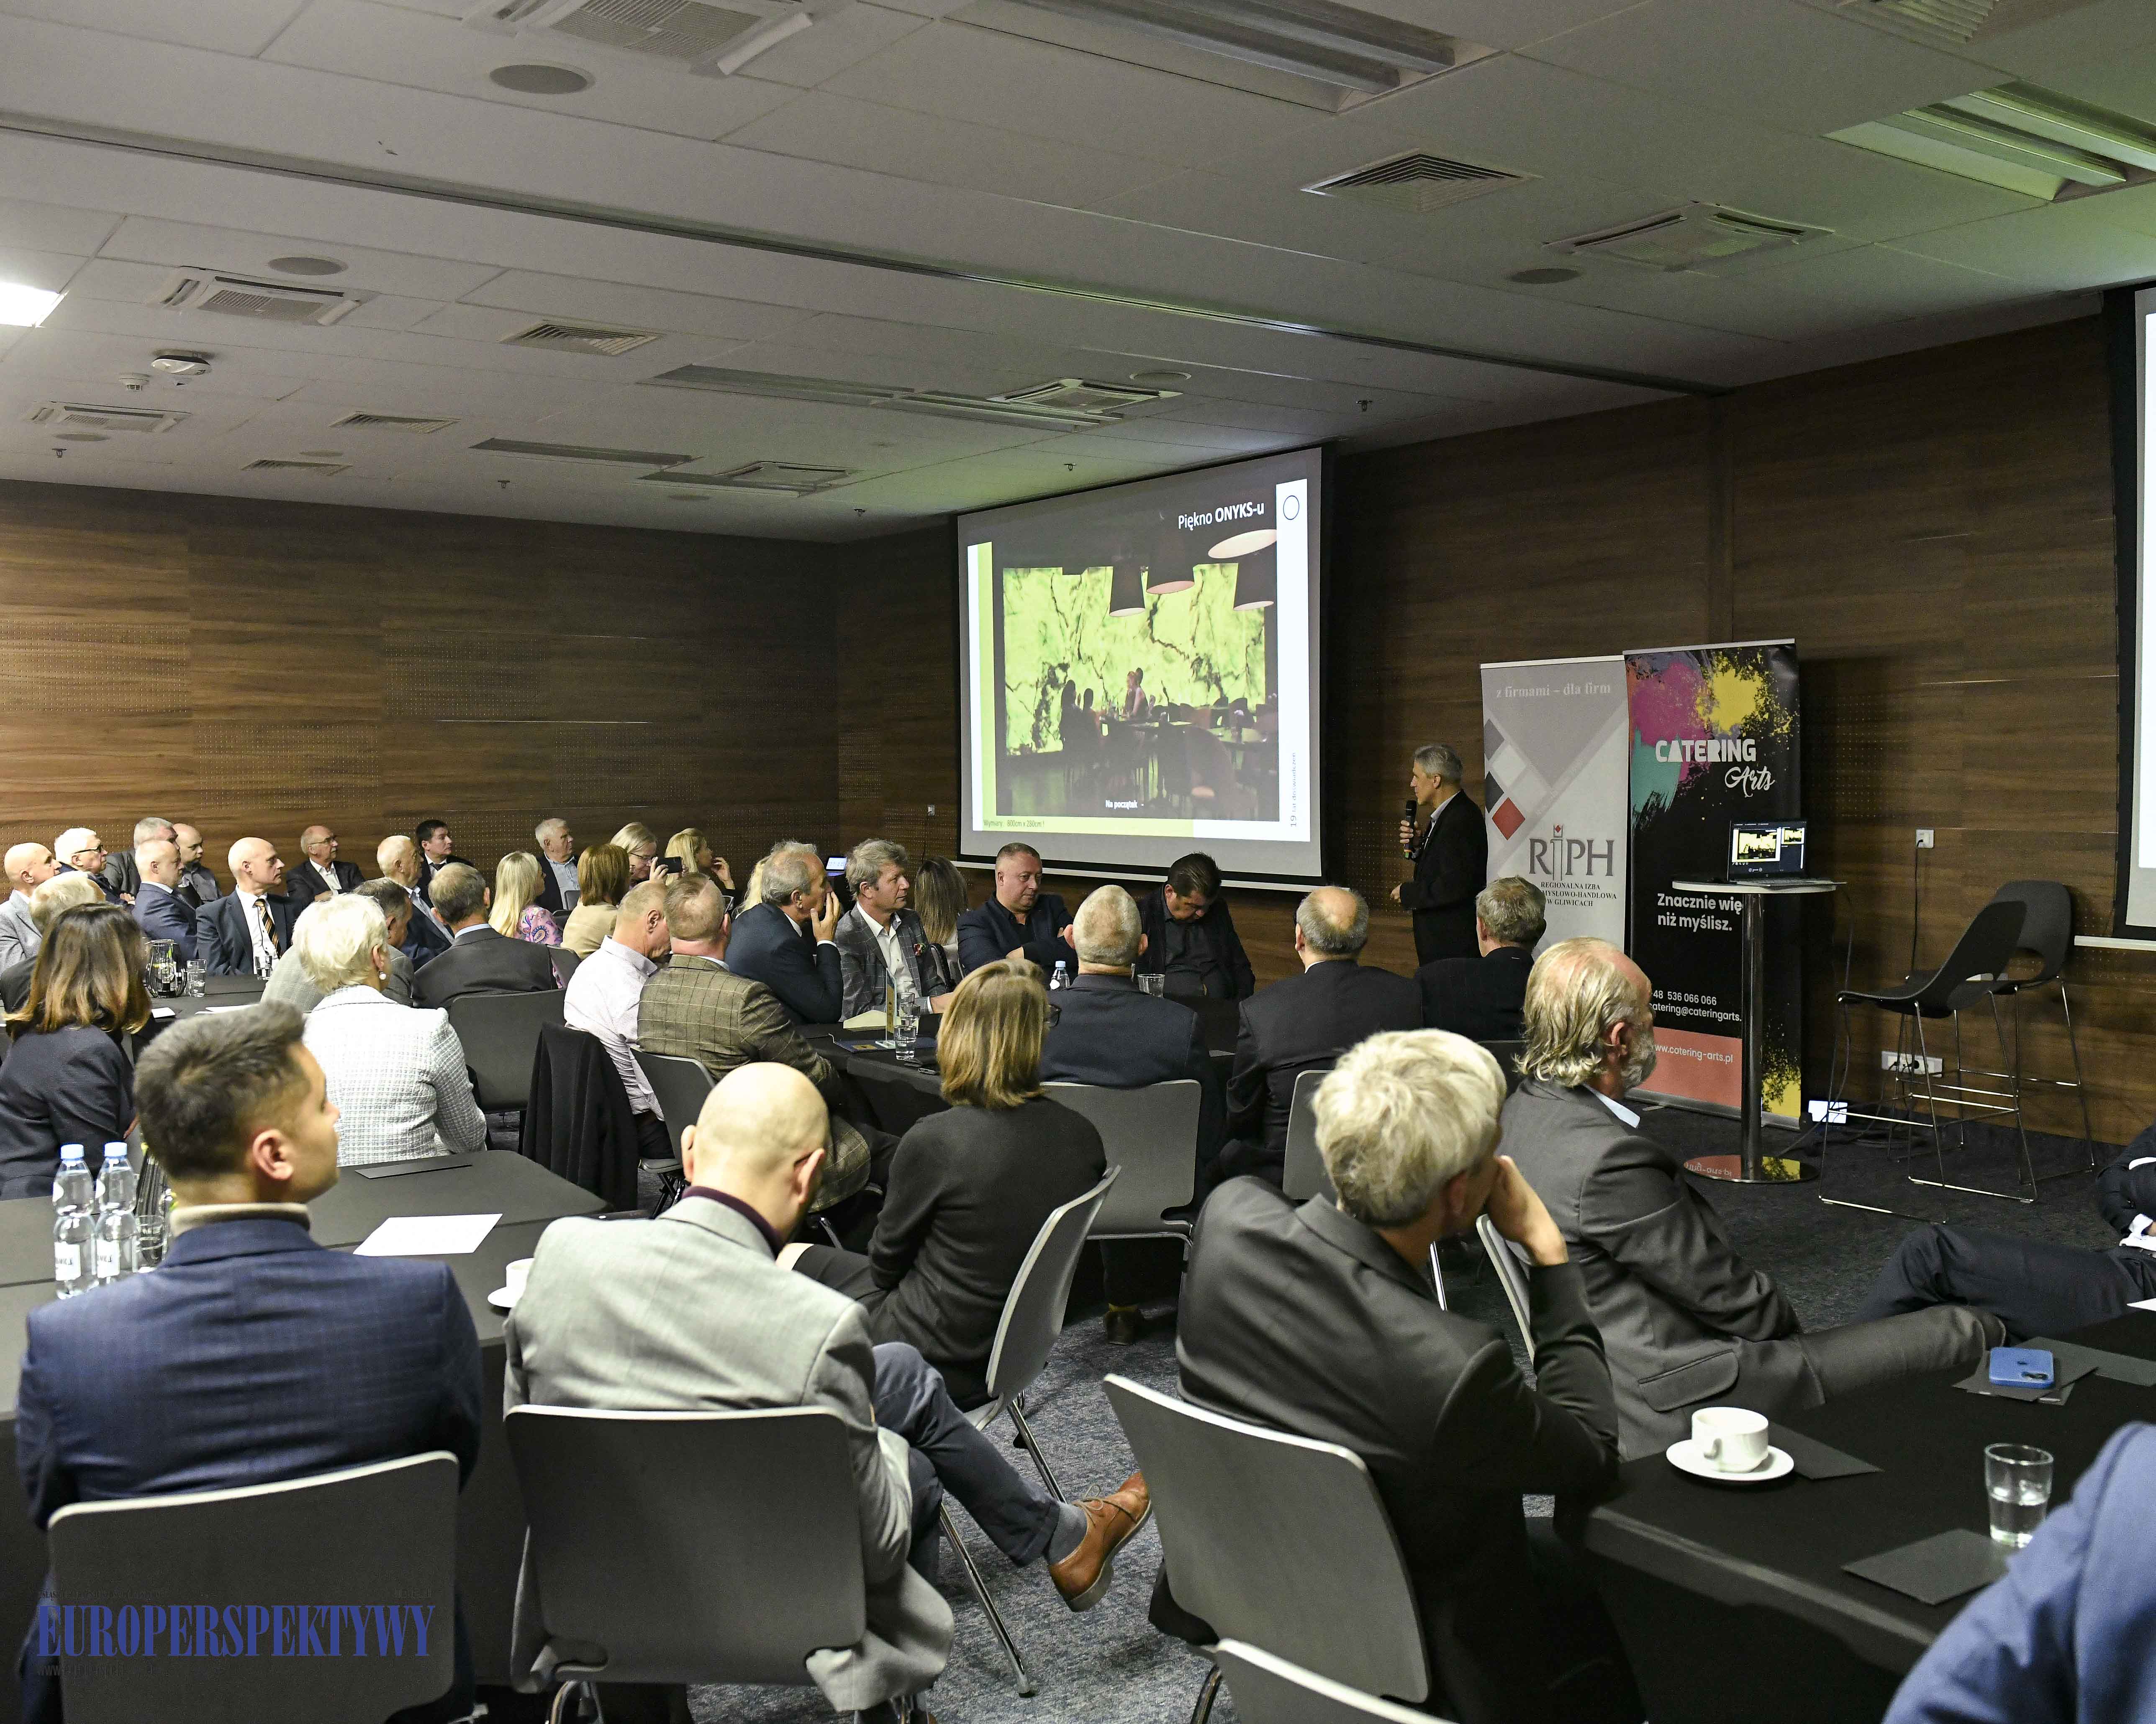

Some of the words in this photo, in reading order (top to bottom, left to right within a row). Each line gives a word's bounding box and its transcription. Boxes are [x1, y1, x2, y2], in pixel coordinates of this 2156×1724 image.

[1178, 512, 1212, 531] Piękno
[1215, 501, 1264, 523] ONYKS-u
[1563, 682, 1581, 695] dla
[1655, 739, 1756, 762] CATERING
[1725, 766, 1776, 798] Arts
[1106, 800, 1113, 808] Na
[1290, 816, 1296, 827] 19
[1658, 893, 1716, 909] Znacznie
[1719, 896, 1743, 915] wię
[1658, 911, 1676, 926] niż
[1679, 914, 1732, 932] myślisz.
[1651, 990, 1663, 999] 48
[1668, 991, 1682, 1001] 536
[1684, 993, 1699, 1003] 066
[1701, 995, 1717, 1006] 066
[1649, 1003, 1742, 1022] atering@cateringarts.
[1654, 1044, 1733, 1065] ww.catering-arts.pl
